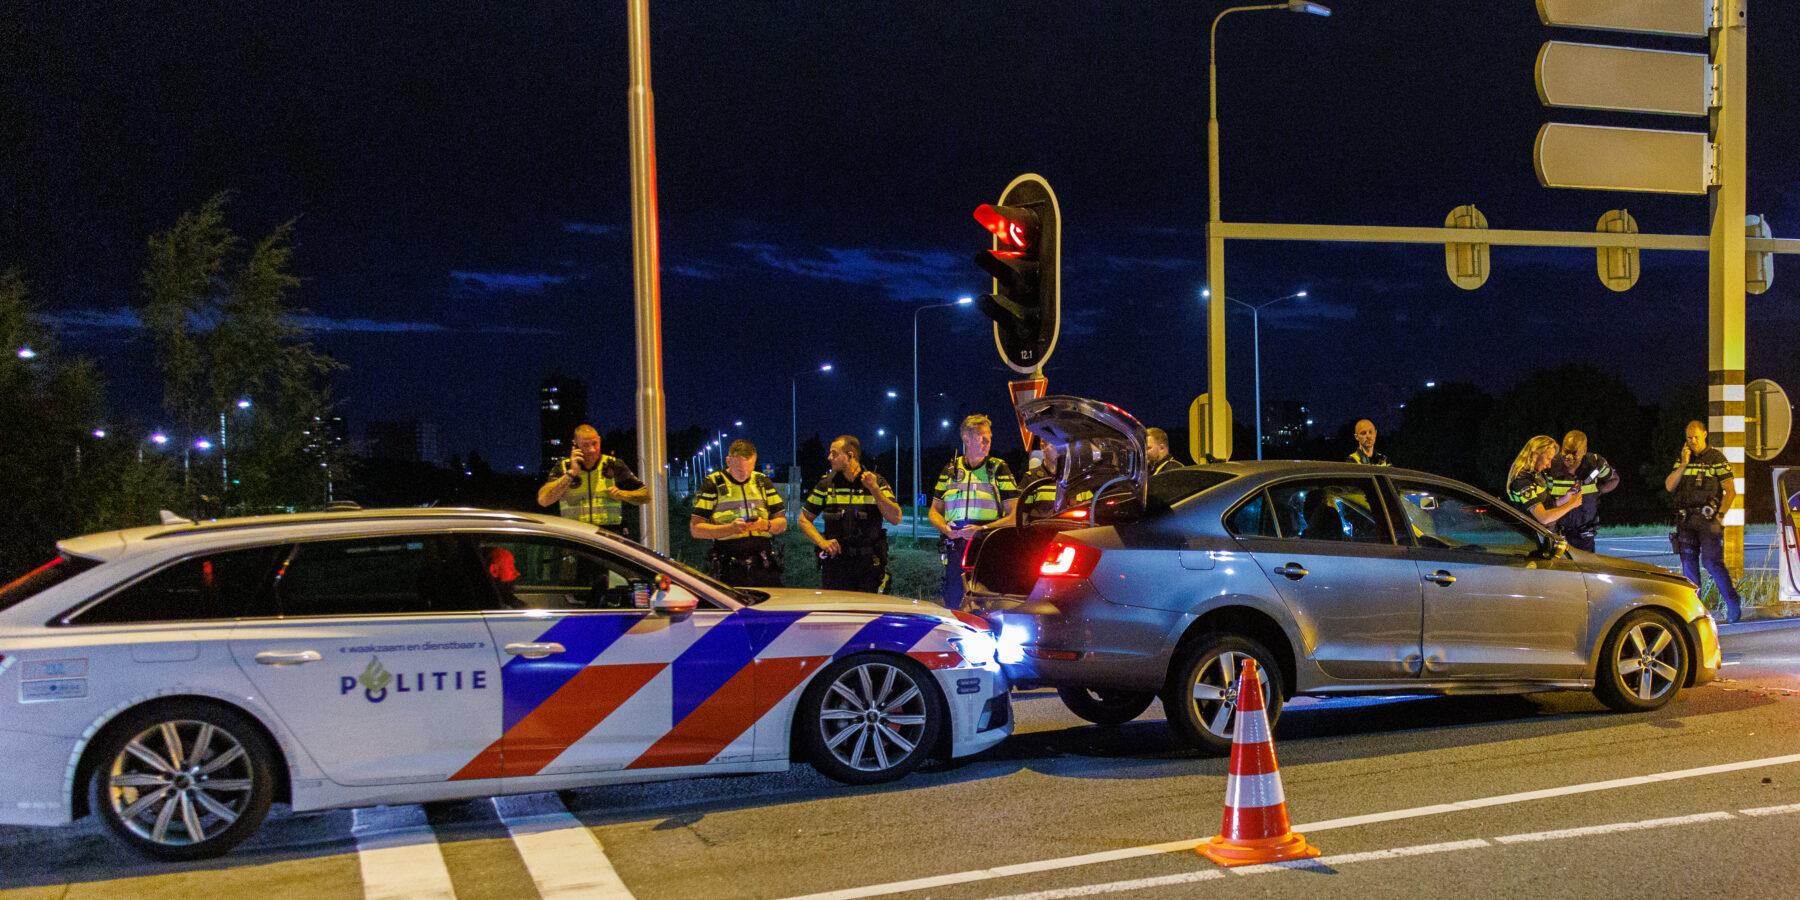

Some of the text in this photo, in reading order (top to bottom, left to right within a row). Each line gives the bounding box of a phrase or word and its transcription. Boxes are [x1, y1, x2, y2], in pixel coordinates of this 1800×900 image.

[1020, 350, 1033, 360] 12.1
[407, 644, 420, 652] en
[422, 641, 476, 651] dienstbaar
[340, 670, 487, 703] POLITIE
